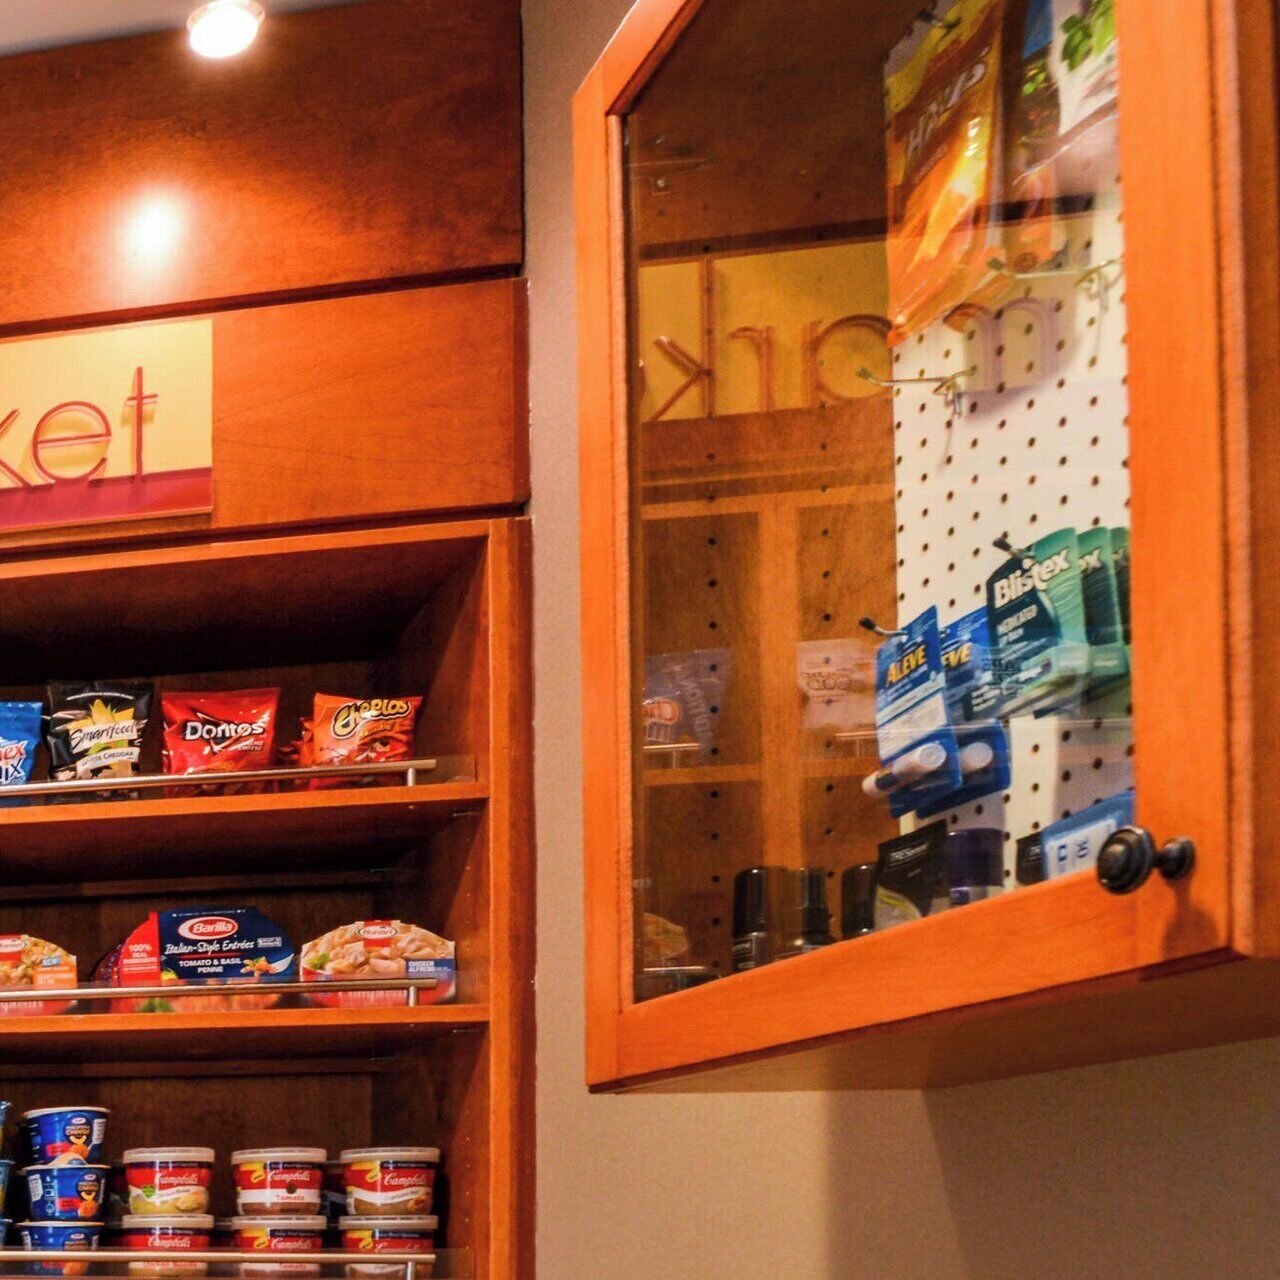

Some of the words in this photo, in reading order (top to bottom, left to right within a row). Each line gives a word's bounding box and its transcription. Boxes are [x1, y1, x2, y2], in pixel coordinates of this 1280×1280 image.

[993, 547, 1071, 609] Blistex
[886, 643, 927, 687] ALEVE
[941, 641, 972, 669] EVE
[333, 698, 410, 738] Cheetos
[70, 719, 143, 752] Smartfood
[185, 719, 268, 741] Doritos
[192, 922, 234, 938] Barilla
[129, 943, 152, 952] 100%
[165, 942, 221, 957] Italian-Style
[223, 936, 255, 951] Entrées
[178, 960, 211, 970] TOMATO
[220, 957, 241, 967] BASIL
[197, 965, 223, 976] PENNE
[269, 1169, 311, 1183] Campbell's
